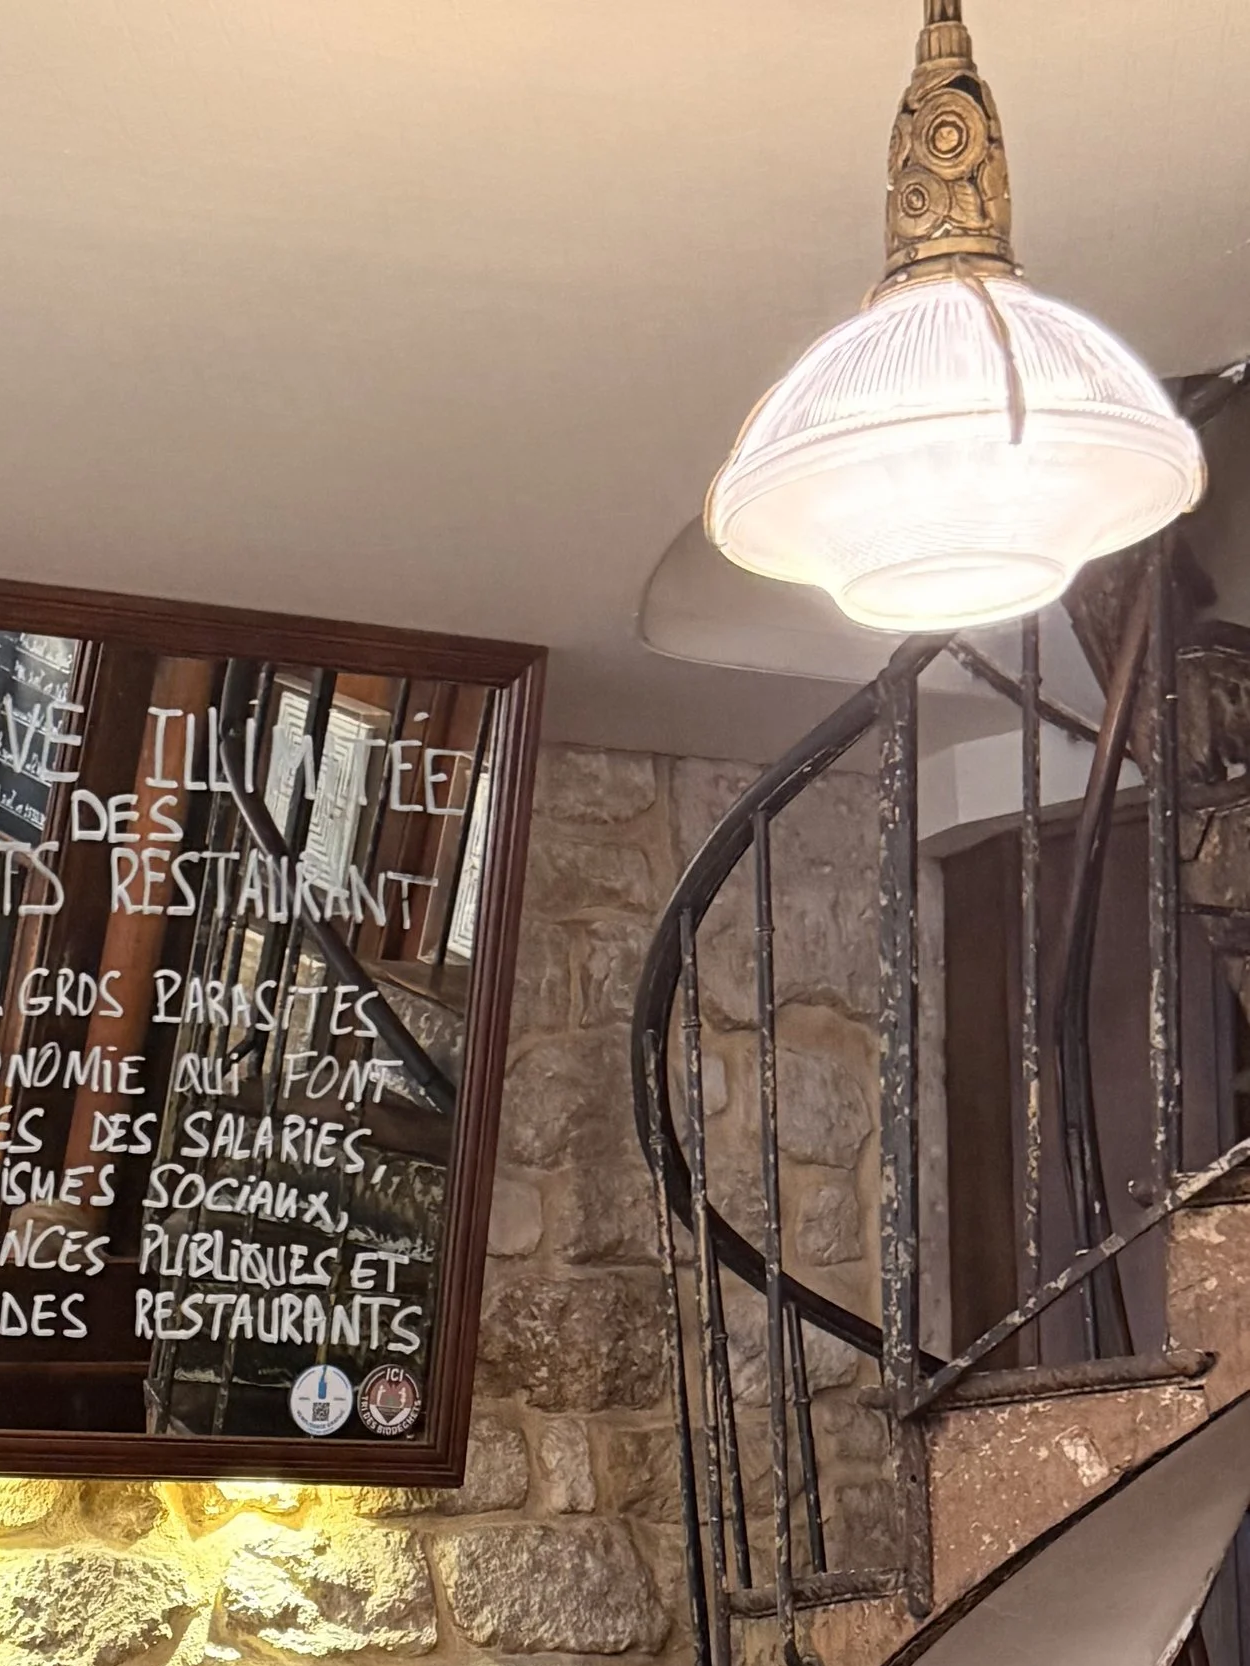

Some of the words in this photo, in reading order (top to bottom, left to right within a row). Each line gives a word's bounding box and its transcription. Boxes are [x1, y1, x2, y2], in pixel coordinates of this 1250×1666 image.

[71, 789, 183, 843] DES
[111, 847, 438, 930] RESTAURANT
[19, 968, 124, 1018] GROS
[152, 969, 379, 1038] PARASITES
[174, 1053, 239, 1096] QUI
[282, 1051, 403, 1103] FONT
[89, 1111, 157, 1154] DES
[140, 1224, 338, 1290] PUBLIQUES
[351, 1252, 410, 1293] ET
[0, 1291, 88, 1338] DES
[135, 1289, 423, 1354] RESTAURANTS
[386, 1368, 404, 1382] ICI
[361, 1396, 369, 1411] TRI
[363, 1412, 378, 1429] DES
